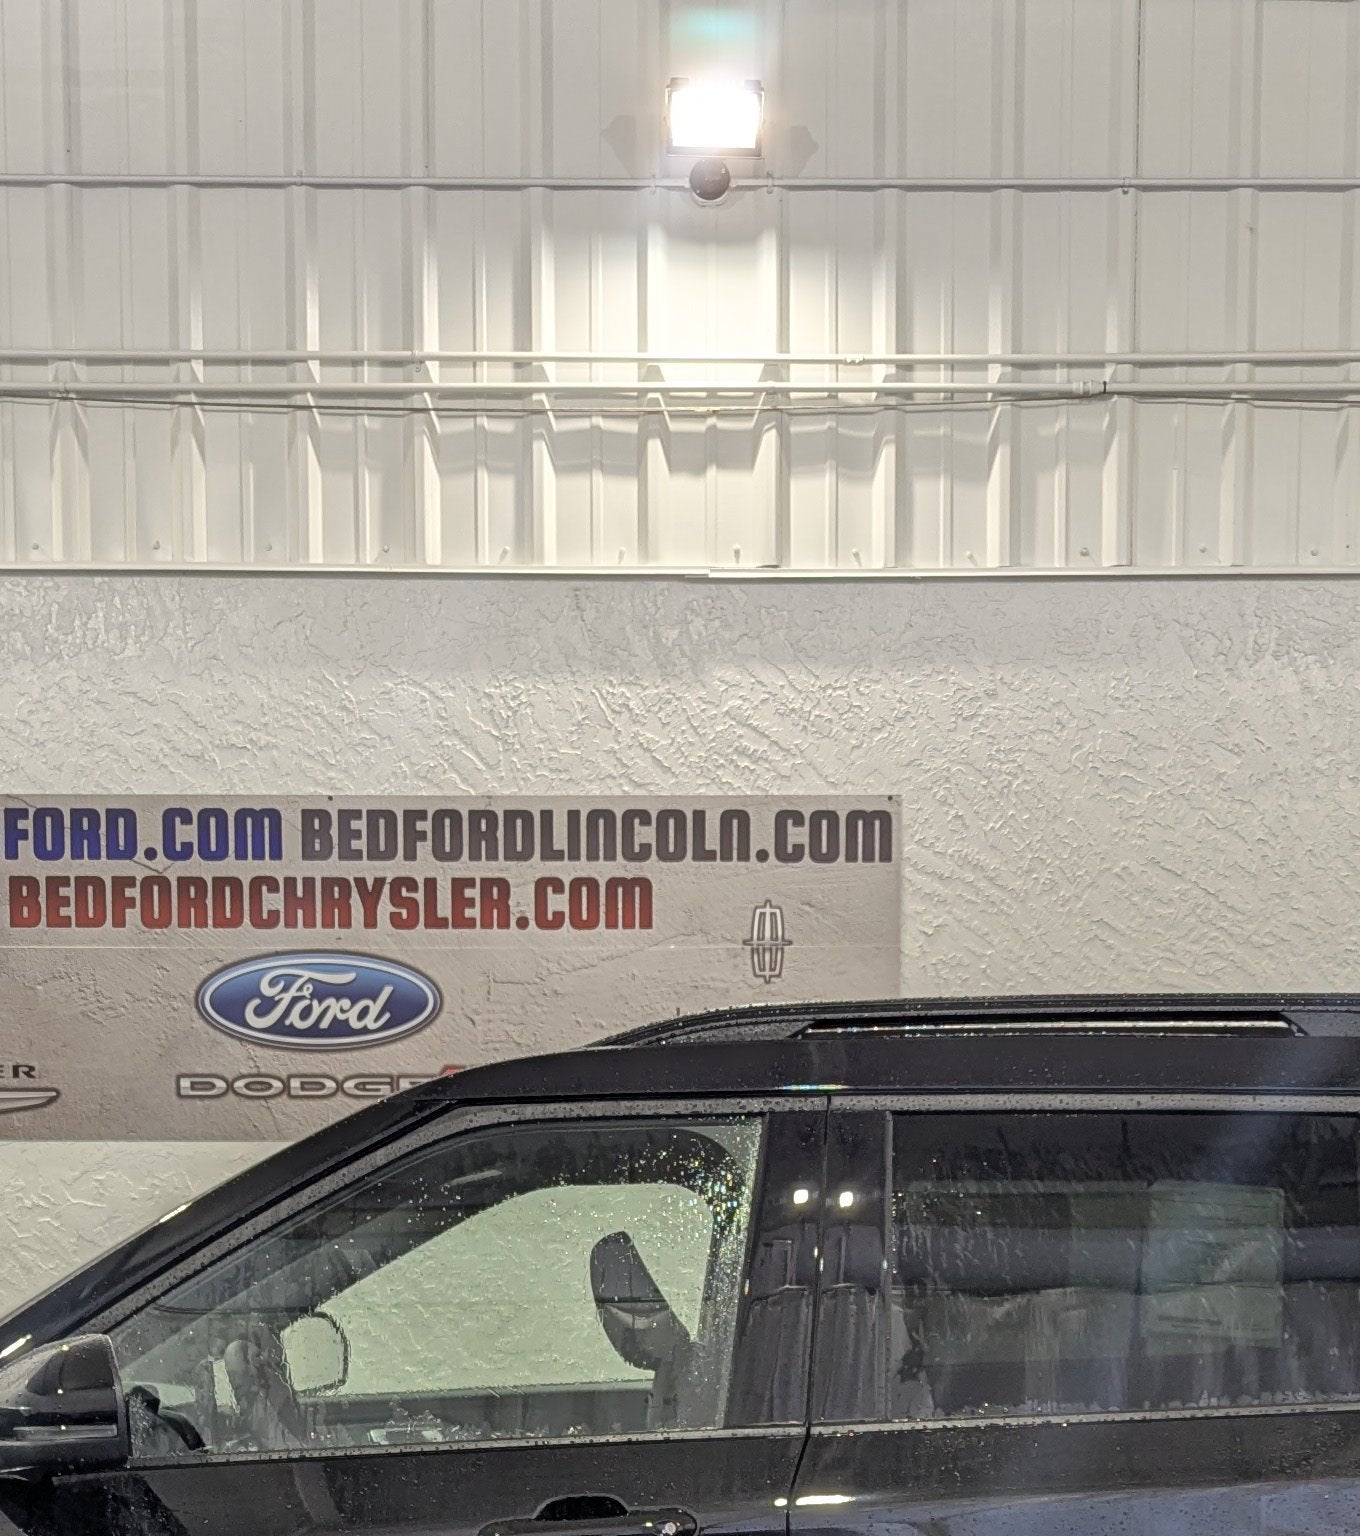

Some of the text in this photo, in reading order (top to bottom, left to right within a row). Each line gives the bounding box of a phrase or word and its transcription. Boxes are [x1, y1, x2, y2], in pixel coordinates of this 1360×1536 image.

[300, 807, 893, 864] BEDFORDLINCOLN.COM
[8, 875, 654, 930] BEDFORDCHRYSLER.COM
[244, 968, 394, 1030] Ford
